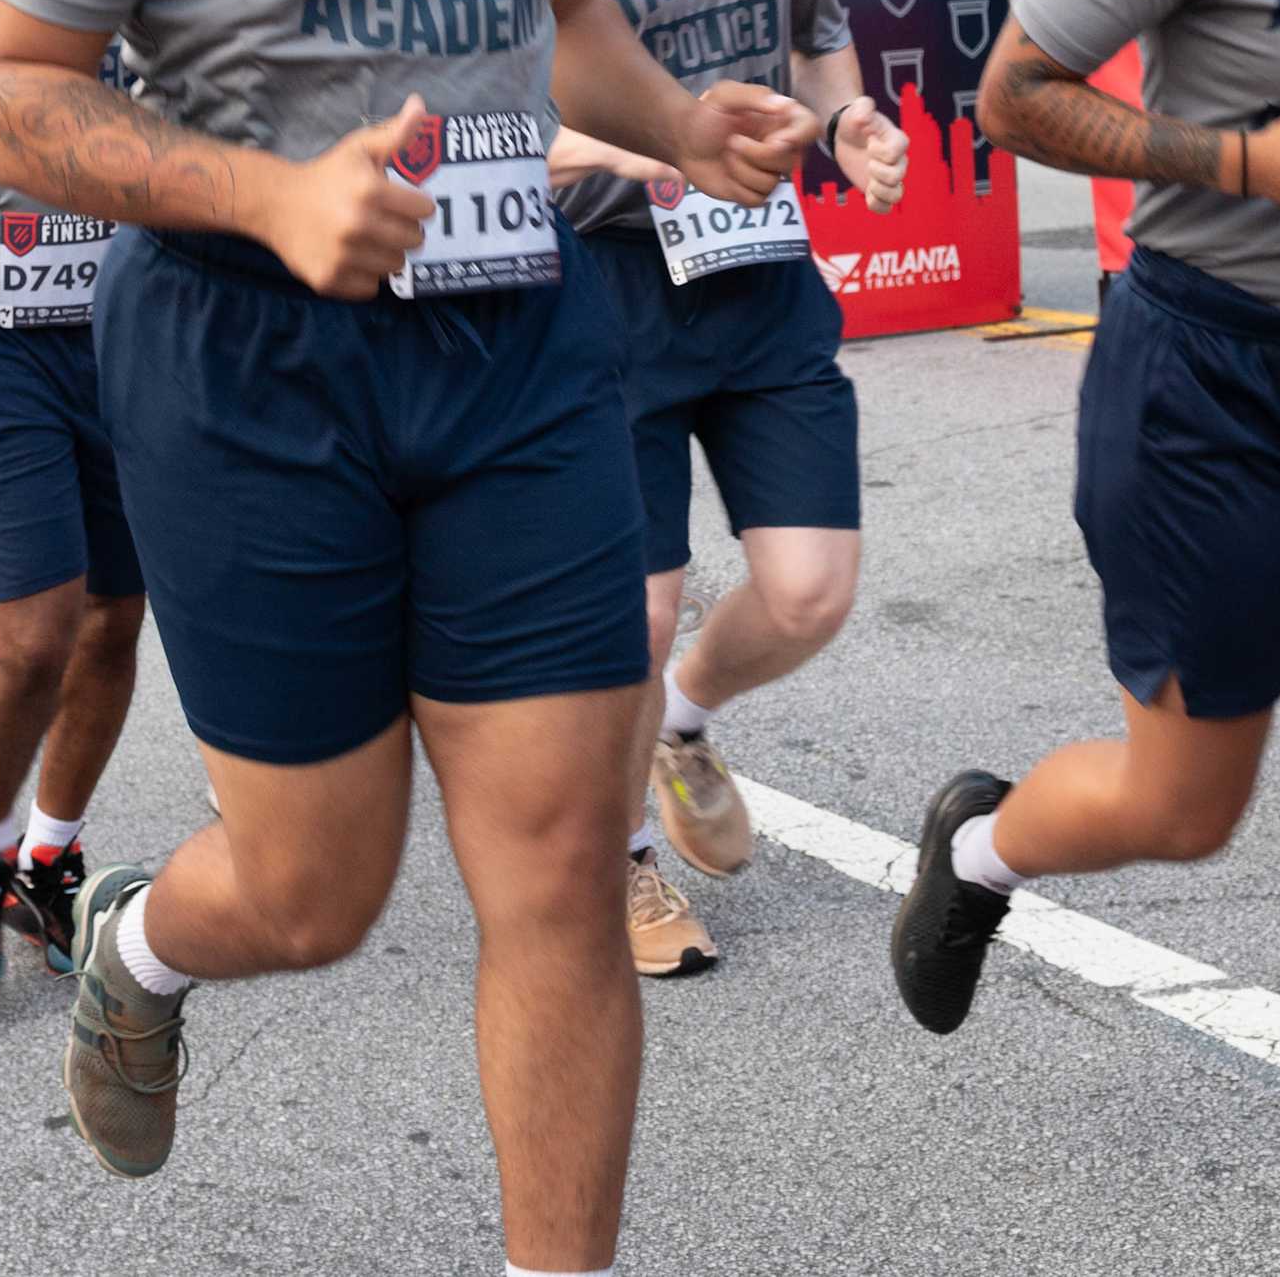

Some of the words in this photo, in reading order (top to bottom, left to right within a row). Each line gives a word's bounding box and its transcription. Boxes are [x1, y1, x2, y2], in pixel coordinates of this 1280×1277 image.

[656, 1, 770, 70] POLICE
[447, 124, 527, 162] FINEST
[41, 220, 105, 243] FINEST
[865, 243, 961, 278] ATLANTA
[865, 274, 915, 290] TRACK
[922, 270, 961, 285] CLUB
